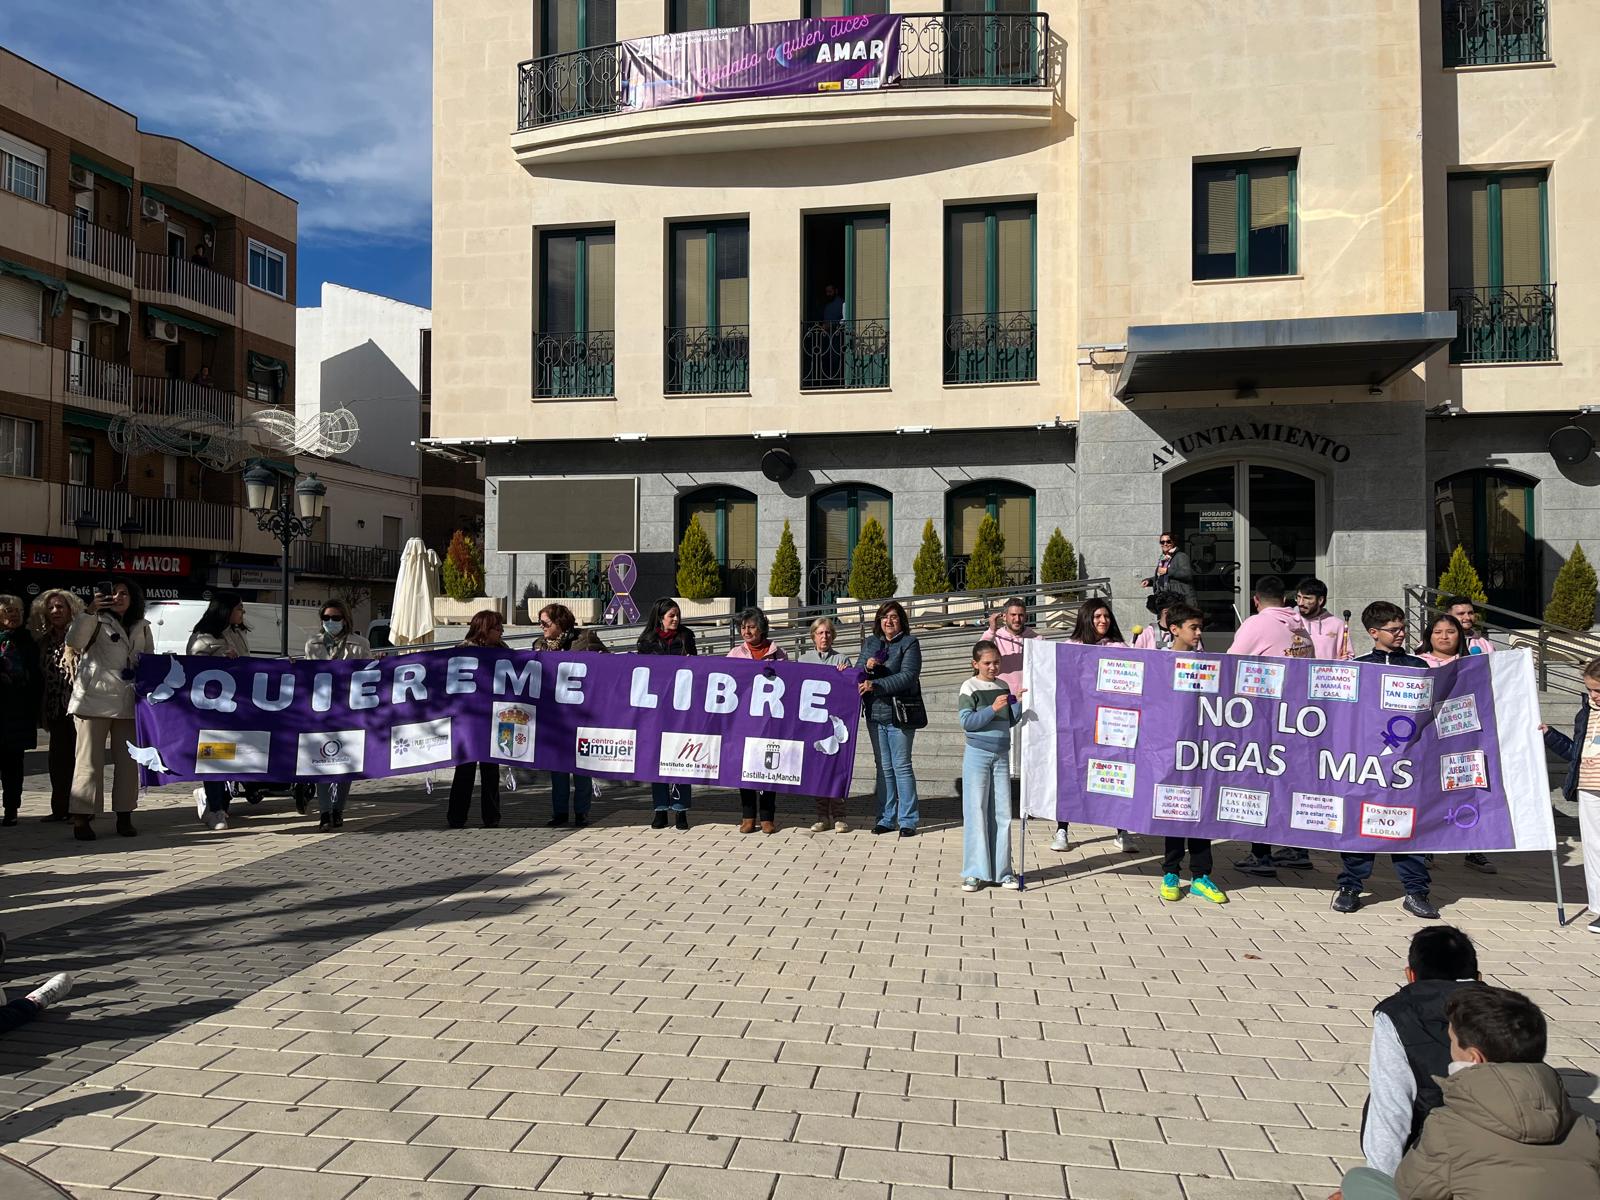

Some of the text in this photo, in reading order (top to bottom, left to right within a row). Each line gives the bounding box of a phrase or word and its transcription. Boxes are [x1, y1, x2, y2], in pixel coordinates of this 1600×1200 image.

[767, 47, 776, 60] a
[783, 30, 824, 59] quien
[830, 15, 869, 38] dices
[816, 40, 884, 63] AMAR
[1152, 422, 1351, 471] AYUNTAMIENTO
[80, 551, 181, 572] PLAA MAYOR
[70, 585, 91, 596] Café
[146, 588, 179, 599] MAYOR
[1246, 666, 1277, 676] ESO ES
[1253, 677, 1266, 685] DE
[1406, 682, 1425, 690] SEAS
[190, 657, 832, 723] QUIÉREME LIBRE
[1242, 686, 1276, 694] CHICAS
[1386, 690, 1401, 698] TAN
[1385, 701, 1407, 709] Pareces
[1198, 696, 1328, 737] NO LO
[1440, 710, 1473, 724] LARGO ES
[590, 742, 634, 759] mujer
[660, 760, 685, 768] Instituto
[1450, 753, 1477, 765] AL FÚTBOL
[1175, 740, 1415, 790] DIGAS MÁS
[1448, 763, 1480, 775] JUEGAN LOS
[1457, 774, 1473, 783] NIÑOS
[1225, 791, 1260, 800] PINTARSE
[1241, 801, 1260, 809] UÑAS
[1366, 806, 1408, 816] LOS NIÑOS
[1379, 818, 1396, 827] NO
[1370, 827, 1401, 836] LLORAN
